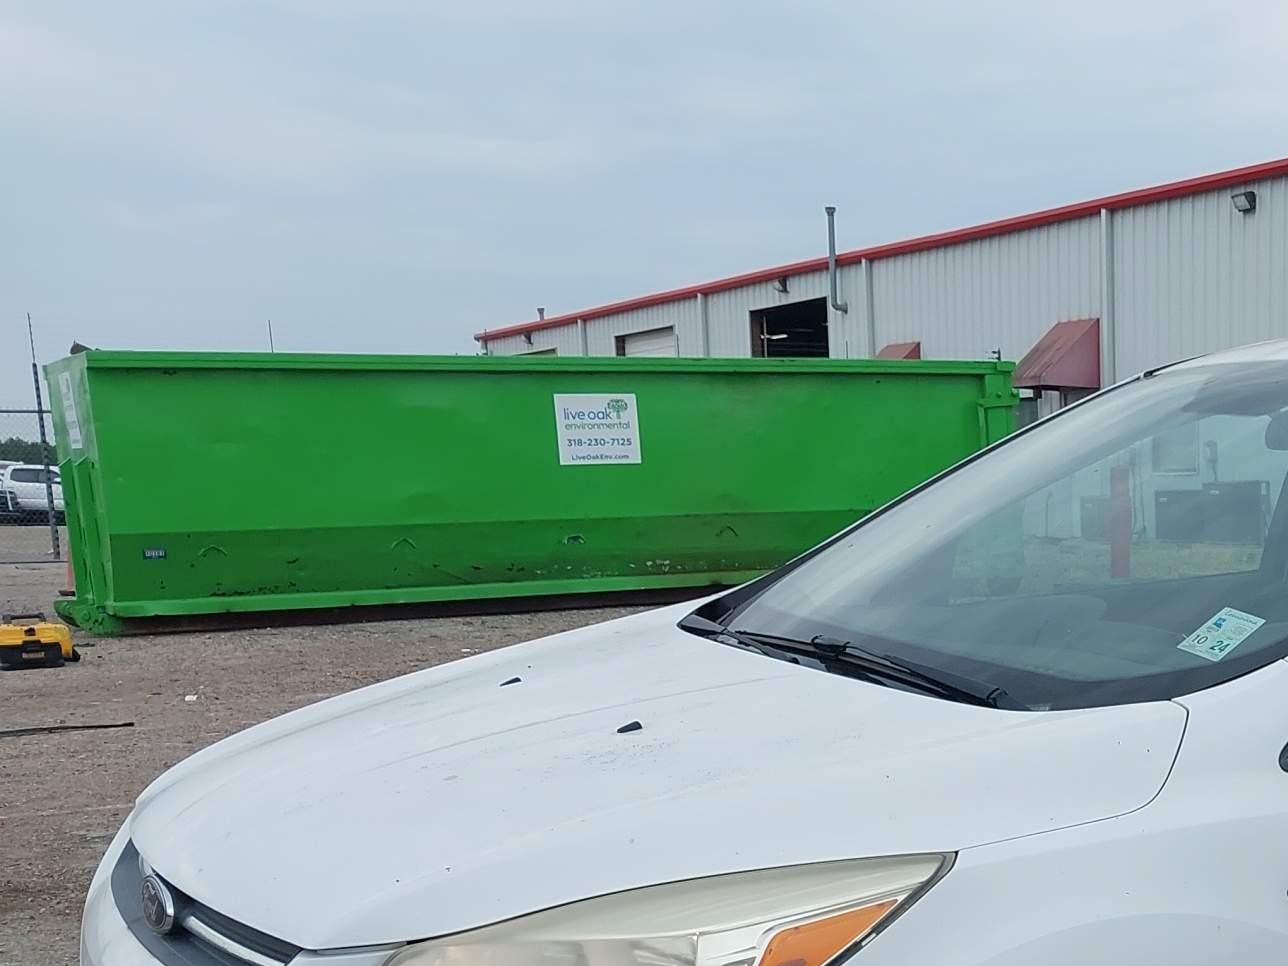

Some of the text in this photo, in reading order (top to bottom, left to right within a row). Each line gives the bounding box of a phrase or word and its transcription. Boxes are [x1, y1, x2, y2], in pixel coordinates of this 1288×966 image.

[564, 408, 613, 420] live oak
[565, 421, 630, 430] environmental
[567, 438, 632, 447] 318-230-7125
[1191, 634, 1208, 645] 10
[1209, 640, 1231, 653] 24
